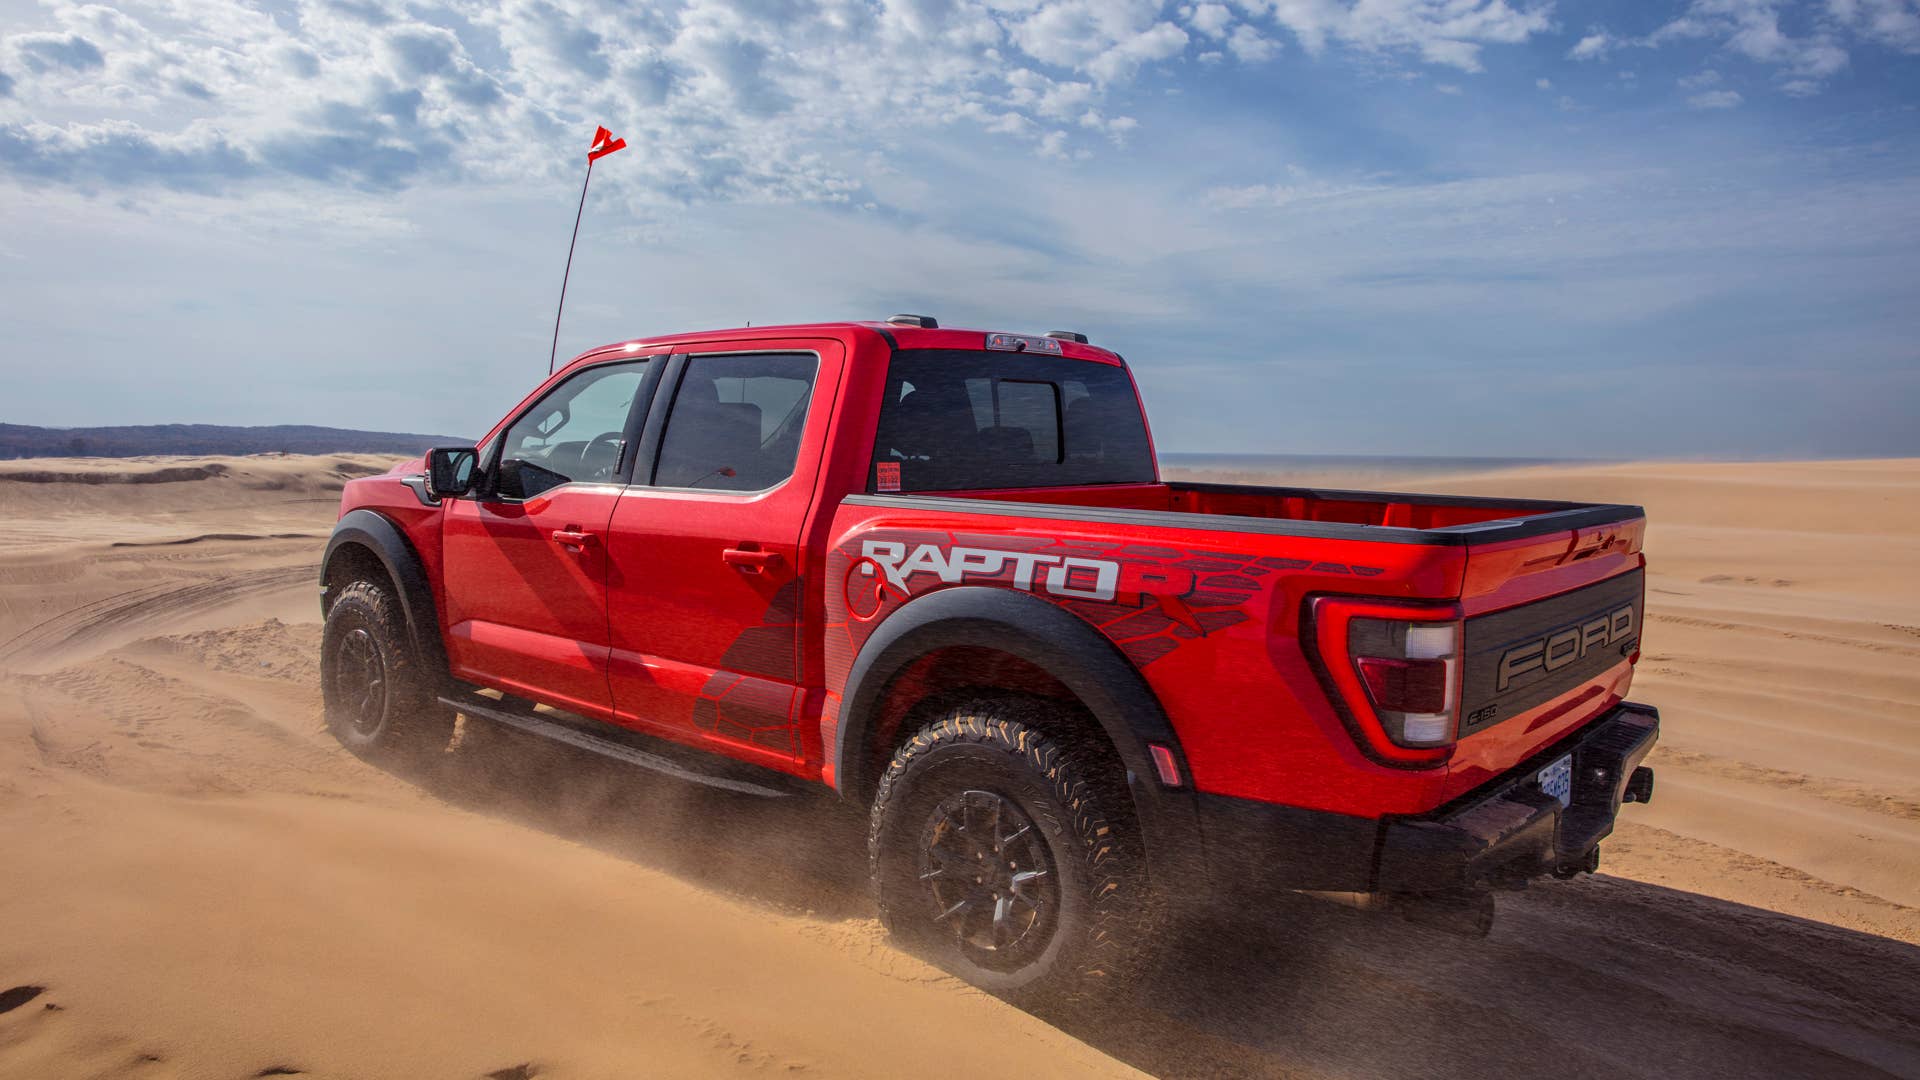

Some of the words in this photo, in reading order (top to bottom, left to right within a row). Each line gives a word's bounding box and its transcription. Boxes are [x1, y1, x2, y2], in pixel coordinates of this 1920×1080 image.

[861, 540, 1207, 638] RAPTOR
[1496, 603, 1634, 693] FORD
[1467, 703, 1498, 726] F-150
